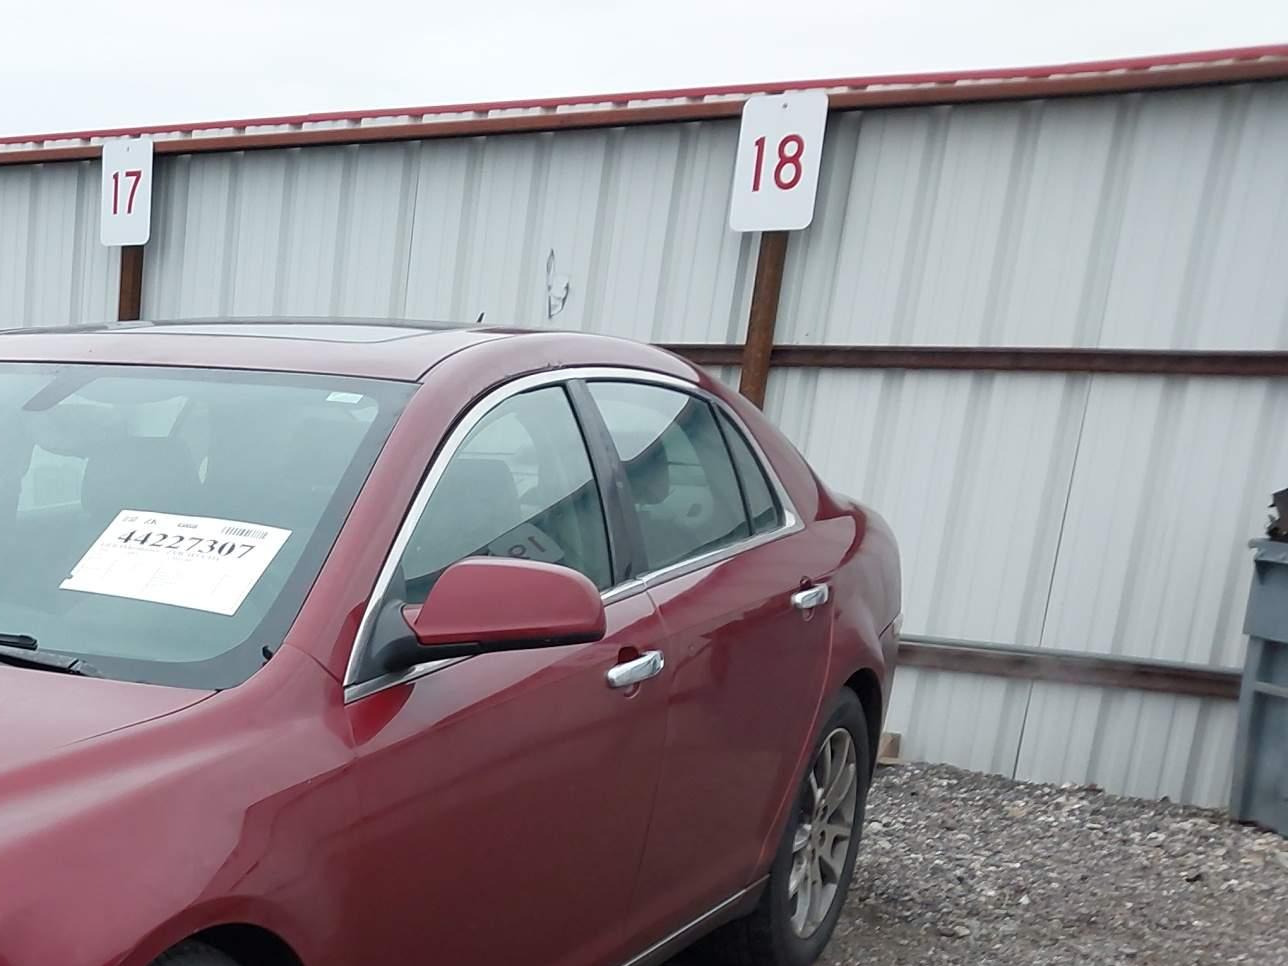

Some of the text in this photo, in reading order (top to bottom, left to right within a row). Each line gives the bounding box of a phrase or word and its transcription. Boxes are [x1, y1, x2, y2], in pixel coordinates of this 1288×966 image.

[752, 134, 804, 191] 18
[112, 170, 142, 215] 17
[117, 529, 256, 559] 44227307
